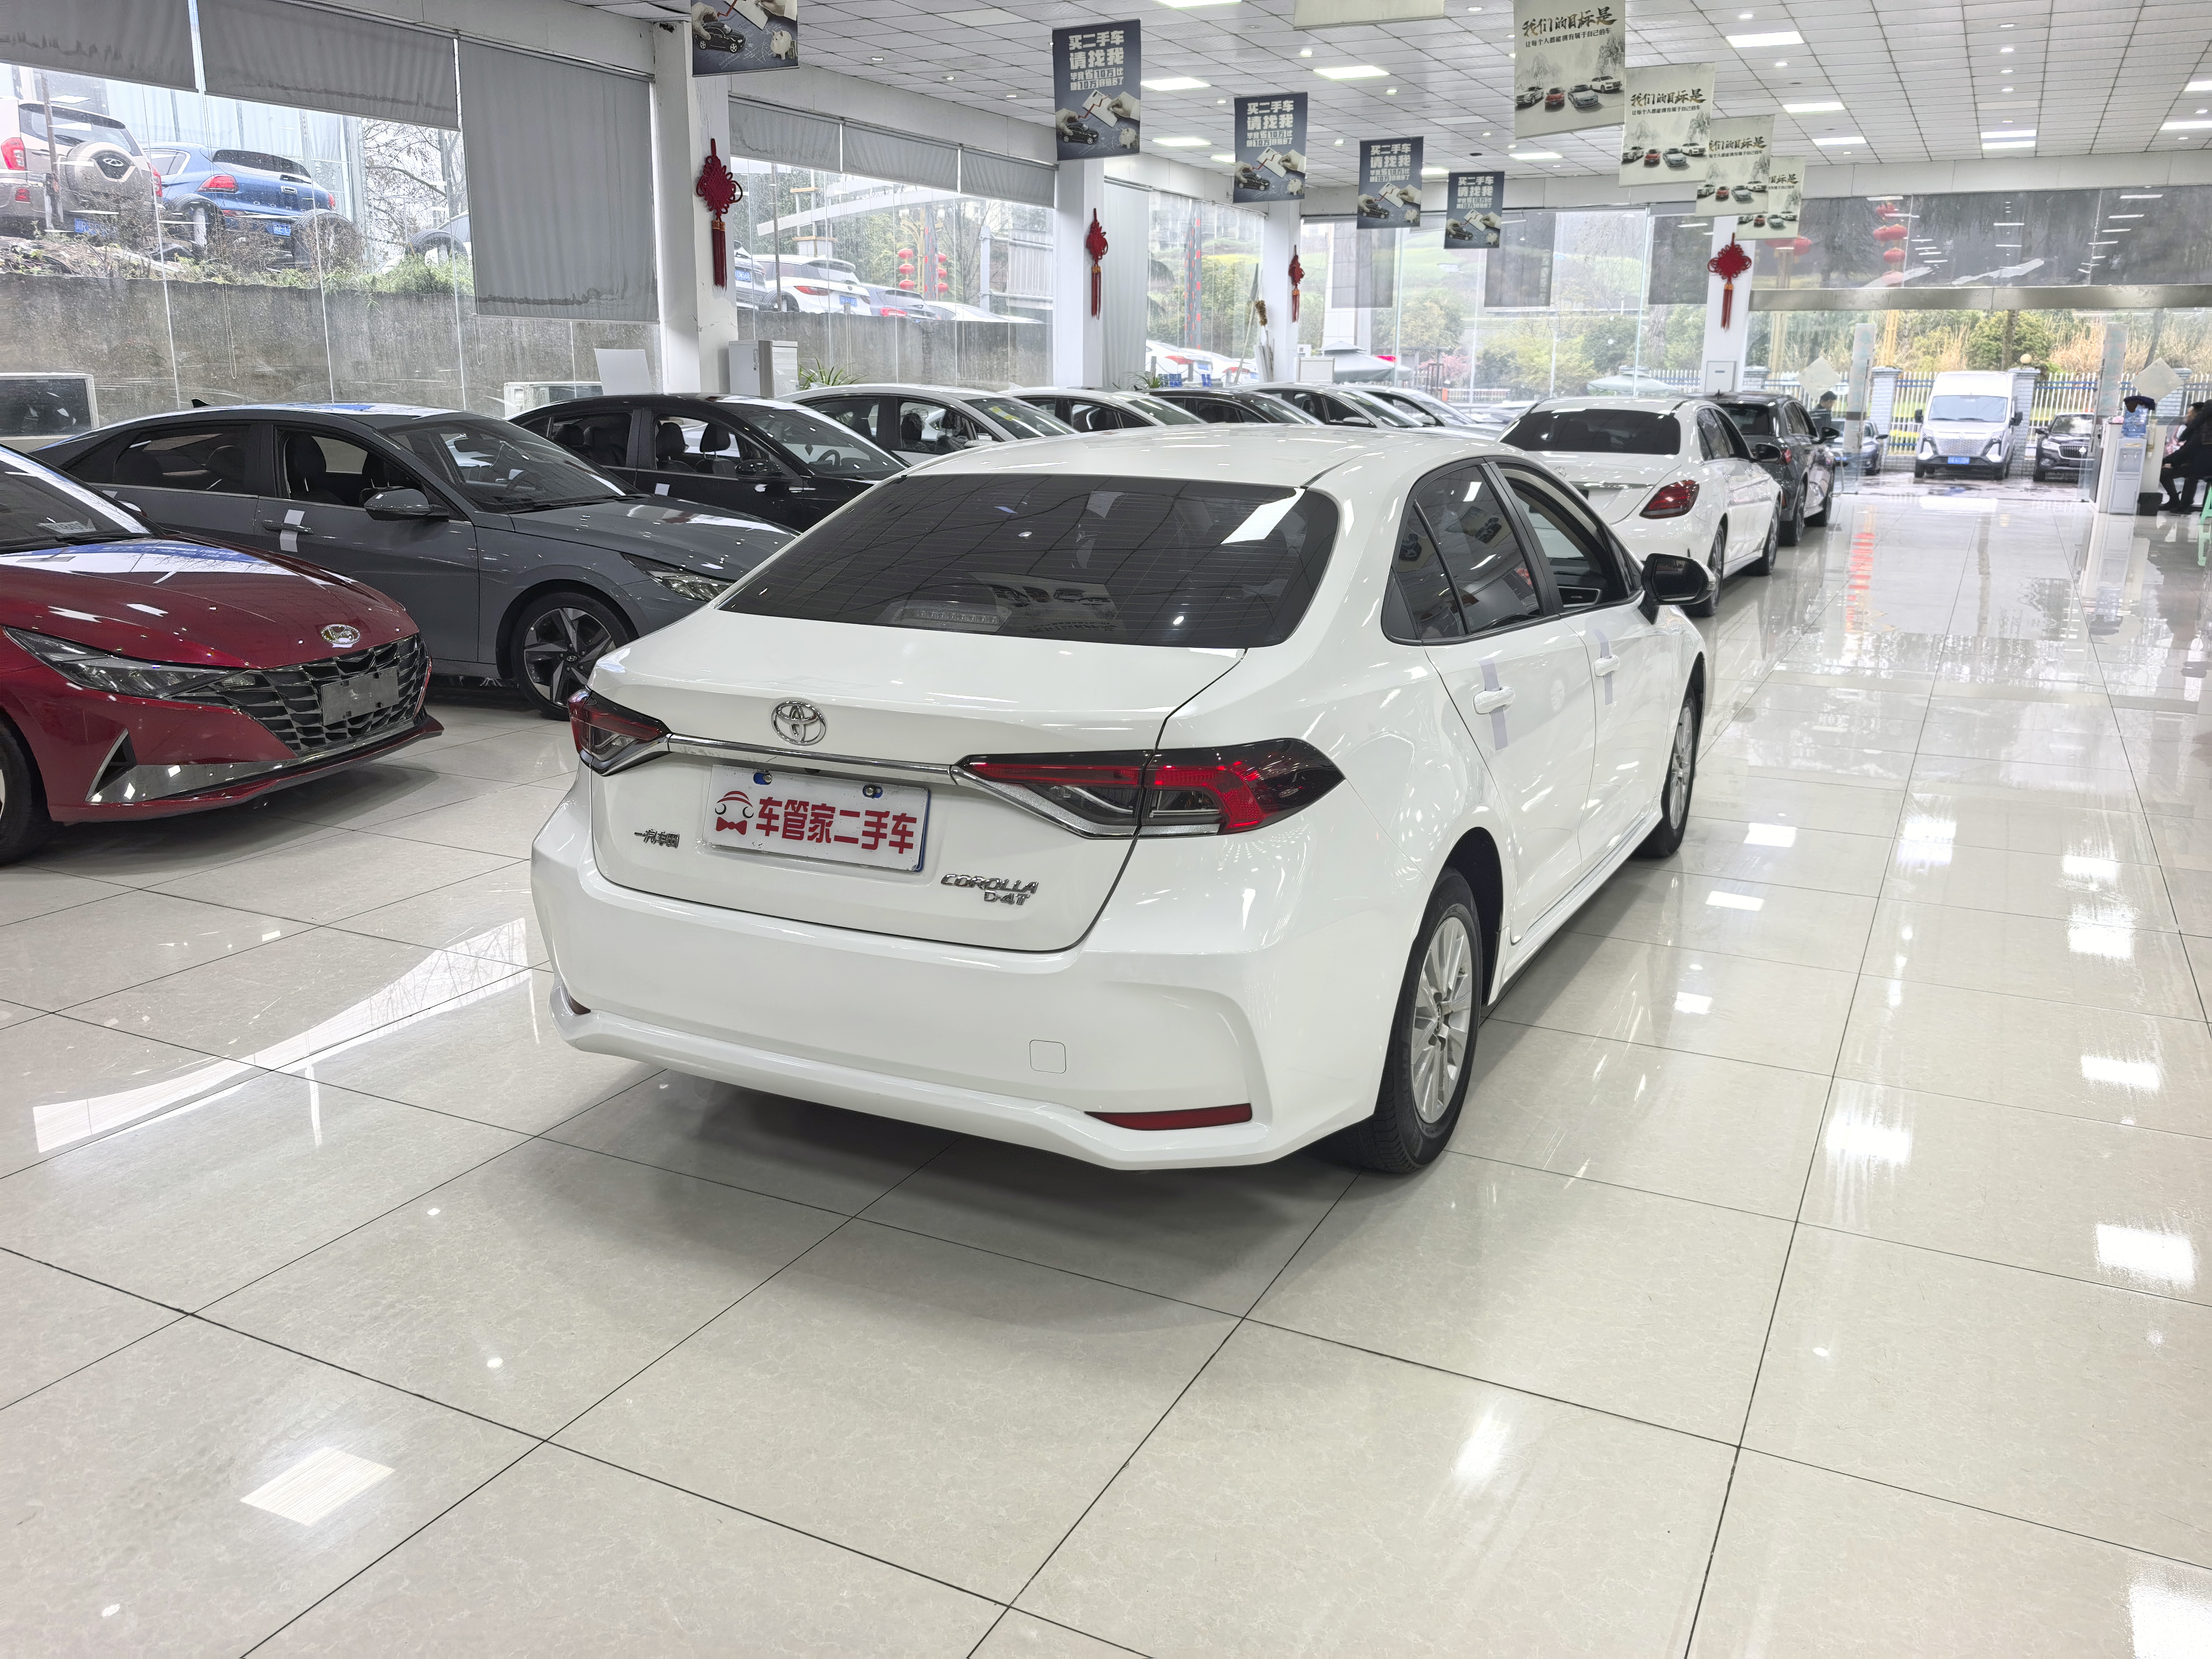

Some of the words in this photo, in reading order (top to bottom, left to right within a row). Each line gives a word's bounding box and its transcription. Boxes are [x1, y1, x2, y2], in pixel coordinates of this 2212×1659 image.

[1522, 6, 1617, 37] 我们的目标是
[1069, 30, 1124, 50] 买二手车
[1070, 47, 1124, 70] 请找我
[1247, 100, 1294, 115] 买二手车
[1247, 114, 1293, 130] 请找我
[756, 797, 917, 854] 车管家二手车
[941, 874, 1038, 894] COROLLA
[984, 889, 1030, 905] D-4T
